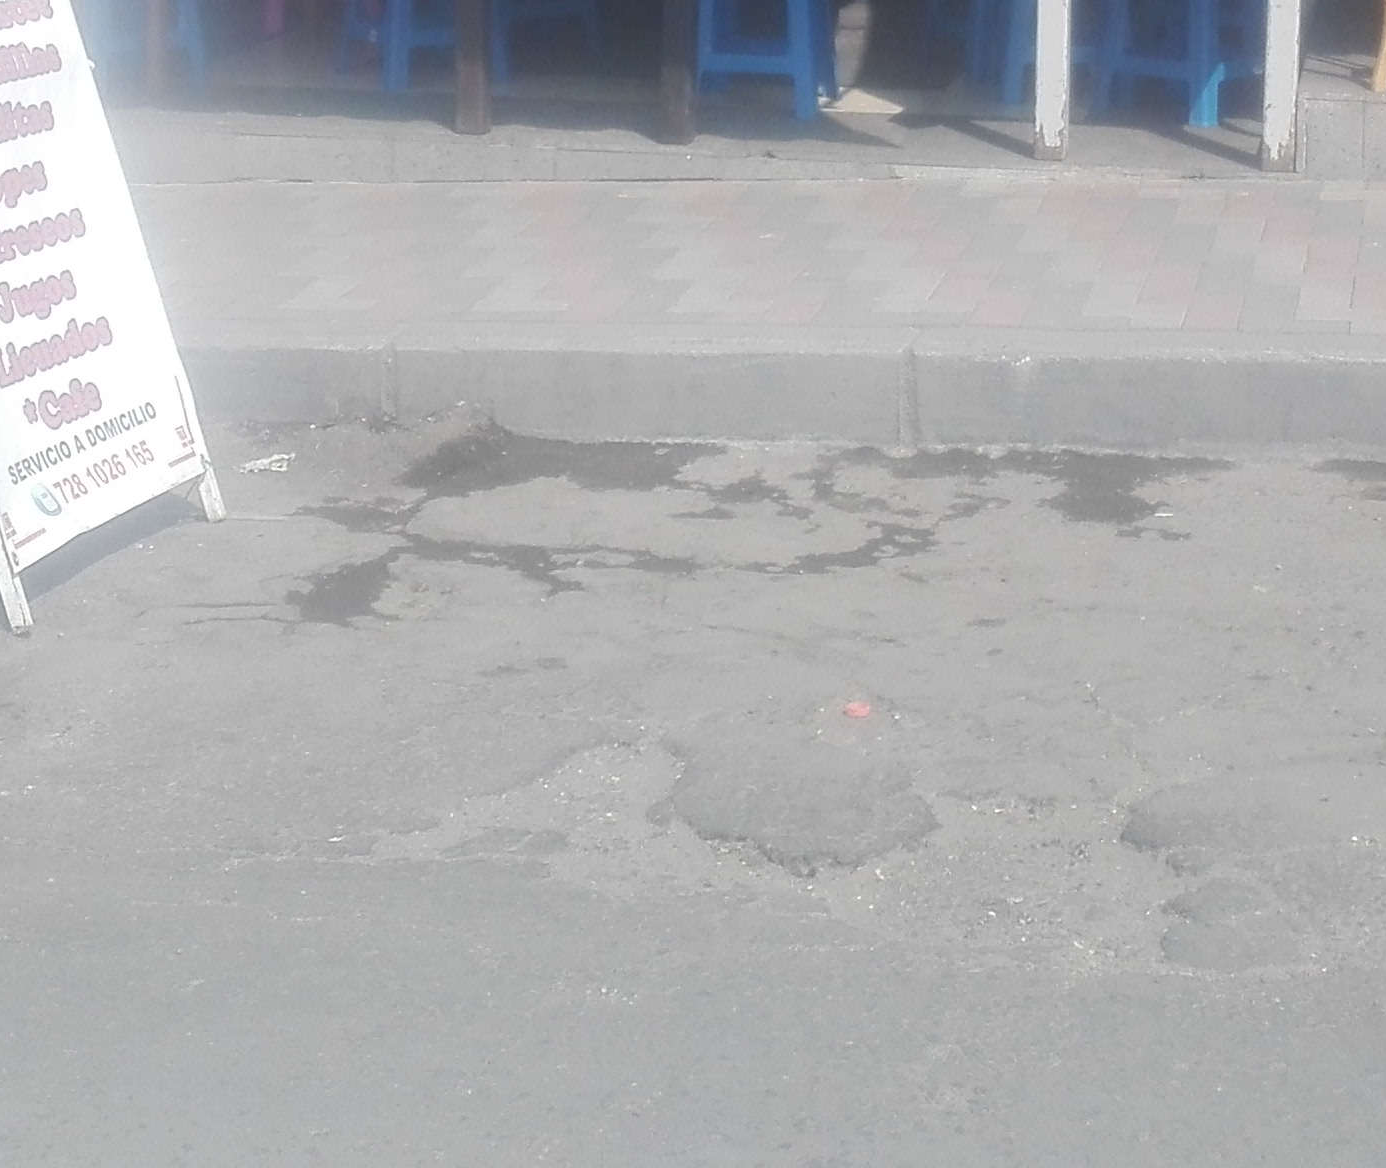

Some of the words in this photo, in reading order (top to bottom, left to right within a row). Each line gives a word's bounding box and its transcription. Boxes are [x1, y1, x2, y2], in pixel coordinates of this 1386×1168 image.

[7, 440, 72, 485] SERVICIO
[74, 434, 87, 454] A
[85, 402, 157, 448] DOMICILIO
[53, 472, 89, 505] 728
[85, 452, 127, 489] 1026
[124, 439, 155, 469] 165
